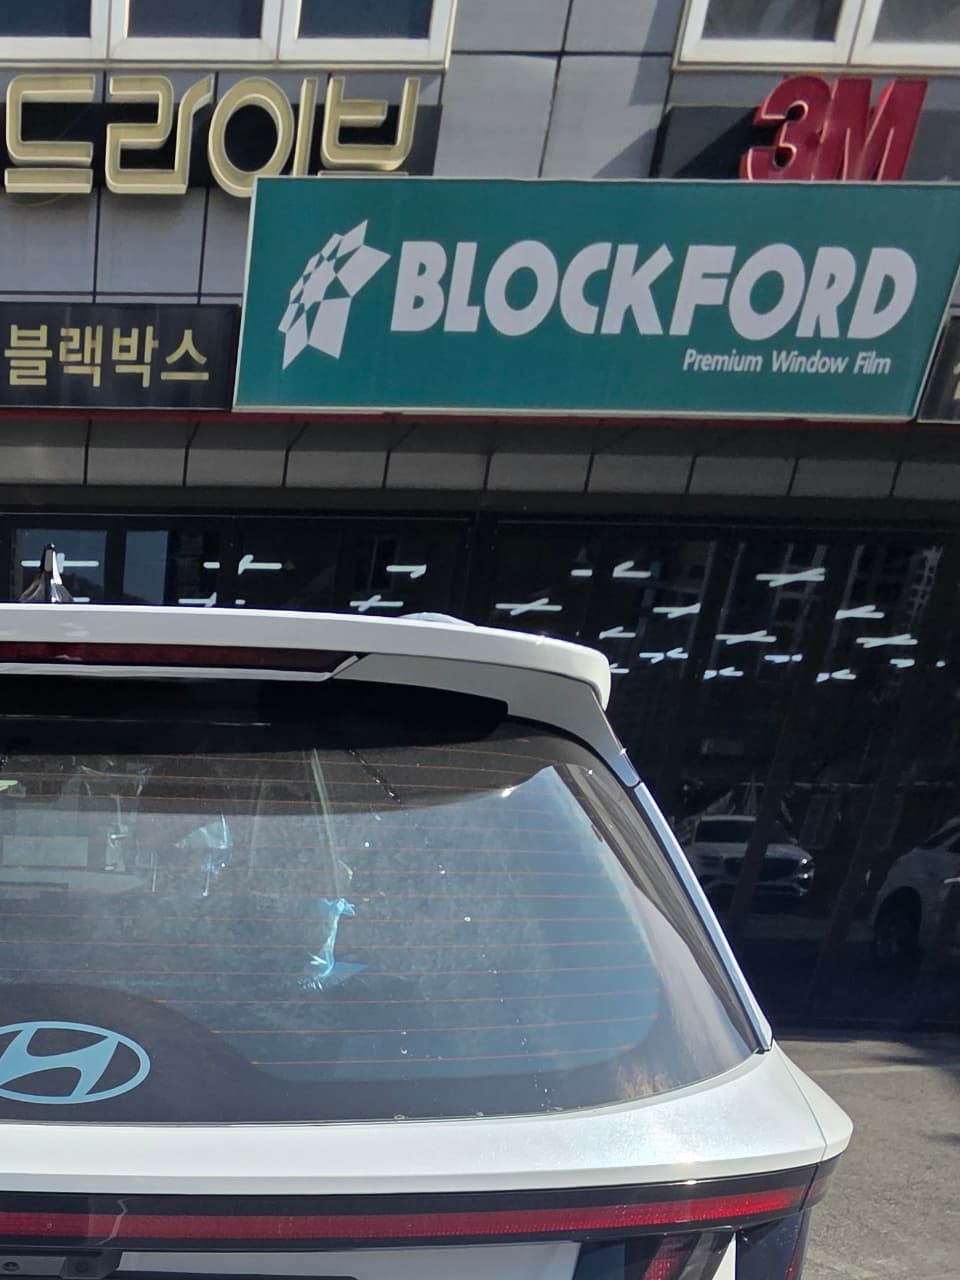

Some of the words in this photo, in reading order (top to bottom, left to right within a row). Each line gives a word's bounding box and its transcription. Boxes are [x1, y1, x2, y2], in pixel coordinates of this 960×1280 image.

[739, 75, 928, 181] 3M
[390, 240, 917, 340] BLOCKFORD
[4, 324, 209, 388] 블랙박스
[682, 348, 763, 372] Premium
[771, 349, 848, 374] Window
[852, 351, 892, 375] Film
